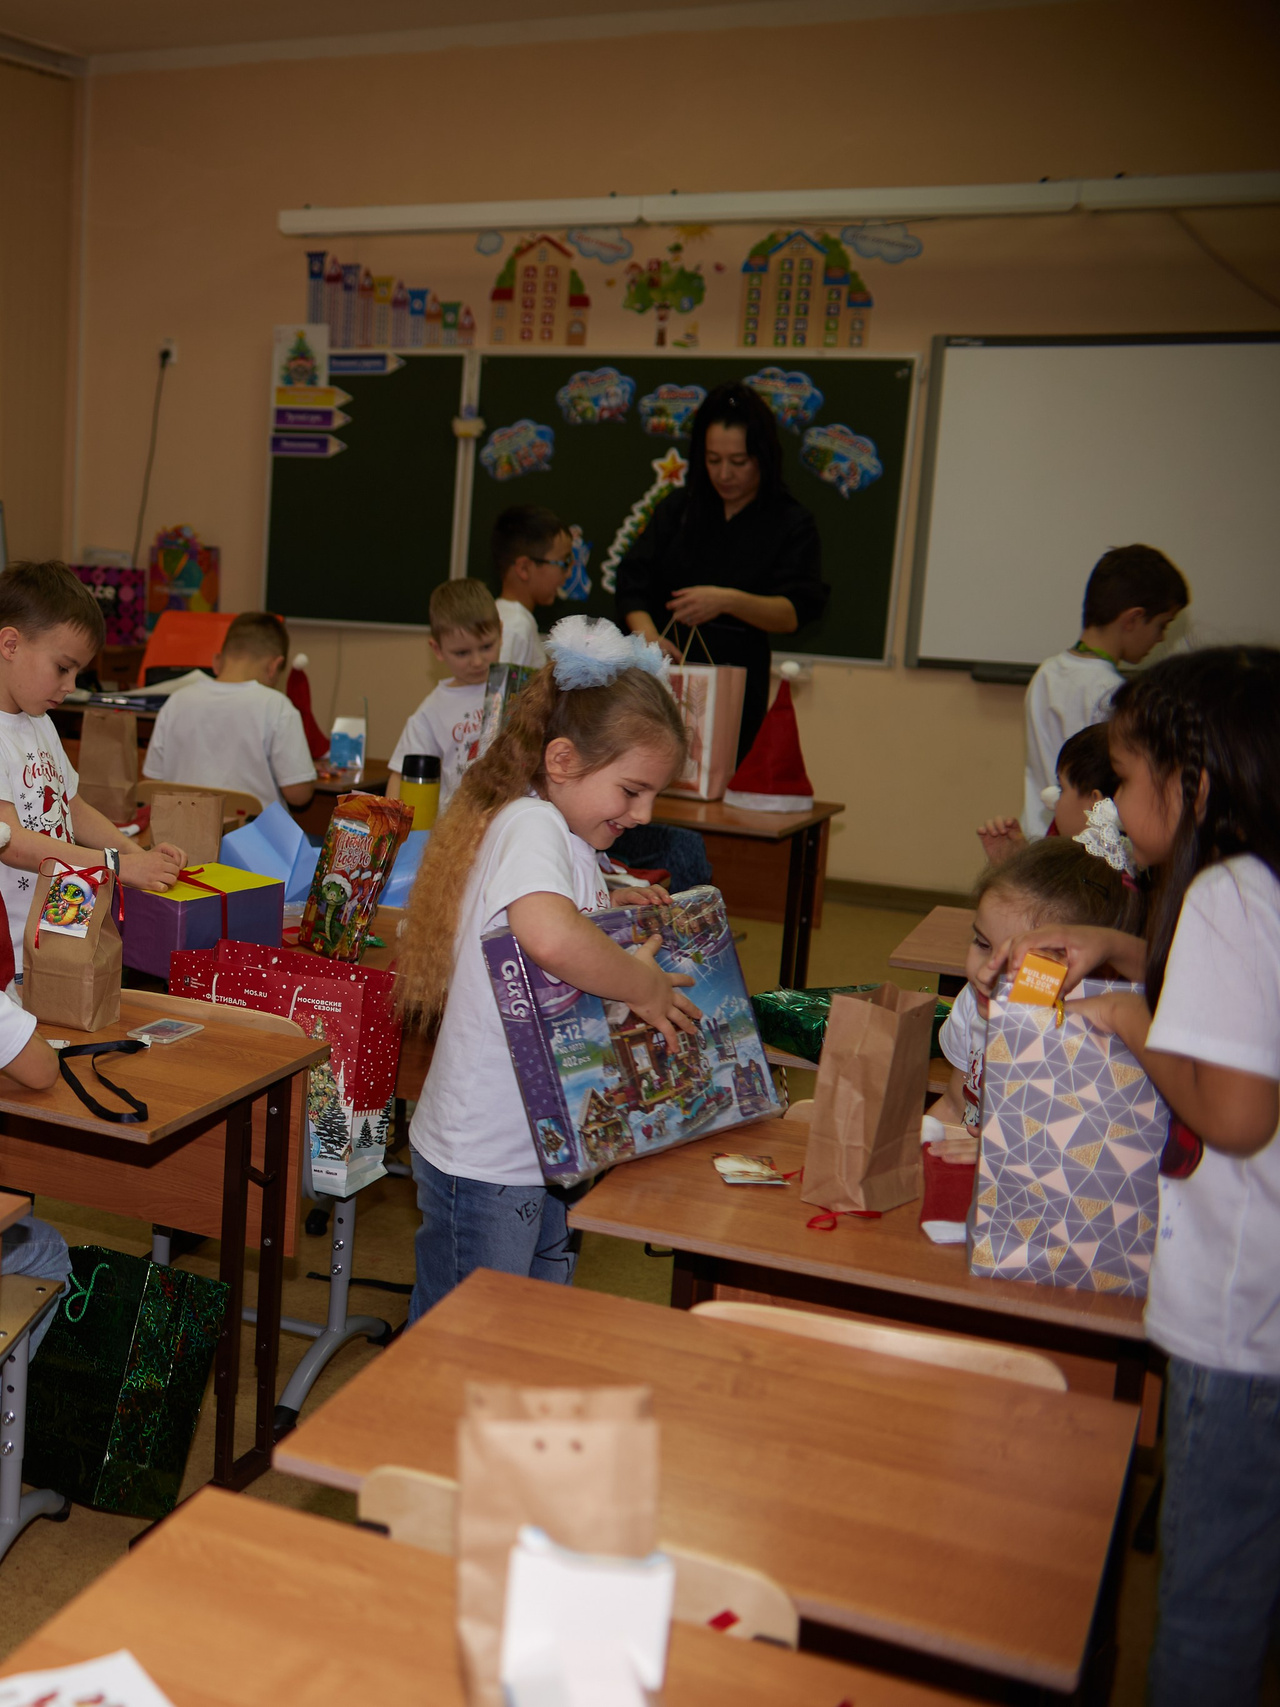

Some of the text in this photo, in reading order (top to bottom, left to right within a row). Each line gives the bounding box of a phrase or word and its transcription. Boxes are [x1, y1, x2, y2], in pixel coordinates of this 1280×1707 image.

[243, 988, 269, 998] MOS.RU
[500, 959, 531, 1019] Girls
[206, 993, 248, 1007] ФСТИВАЛЬ
[297, 996, 343, 1008] МОСКОВСКИЕ
[313, 1004, 342, 1013] СЕЗОНЫ
[553, 1023, 583, 1044] 5-12
[515, 1200, 538, 1222] YES
